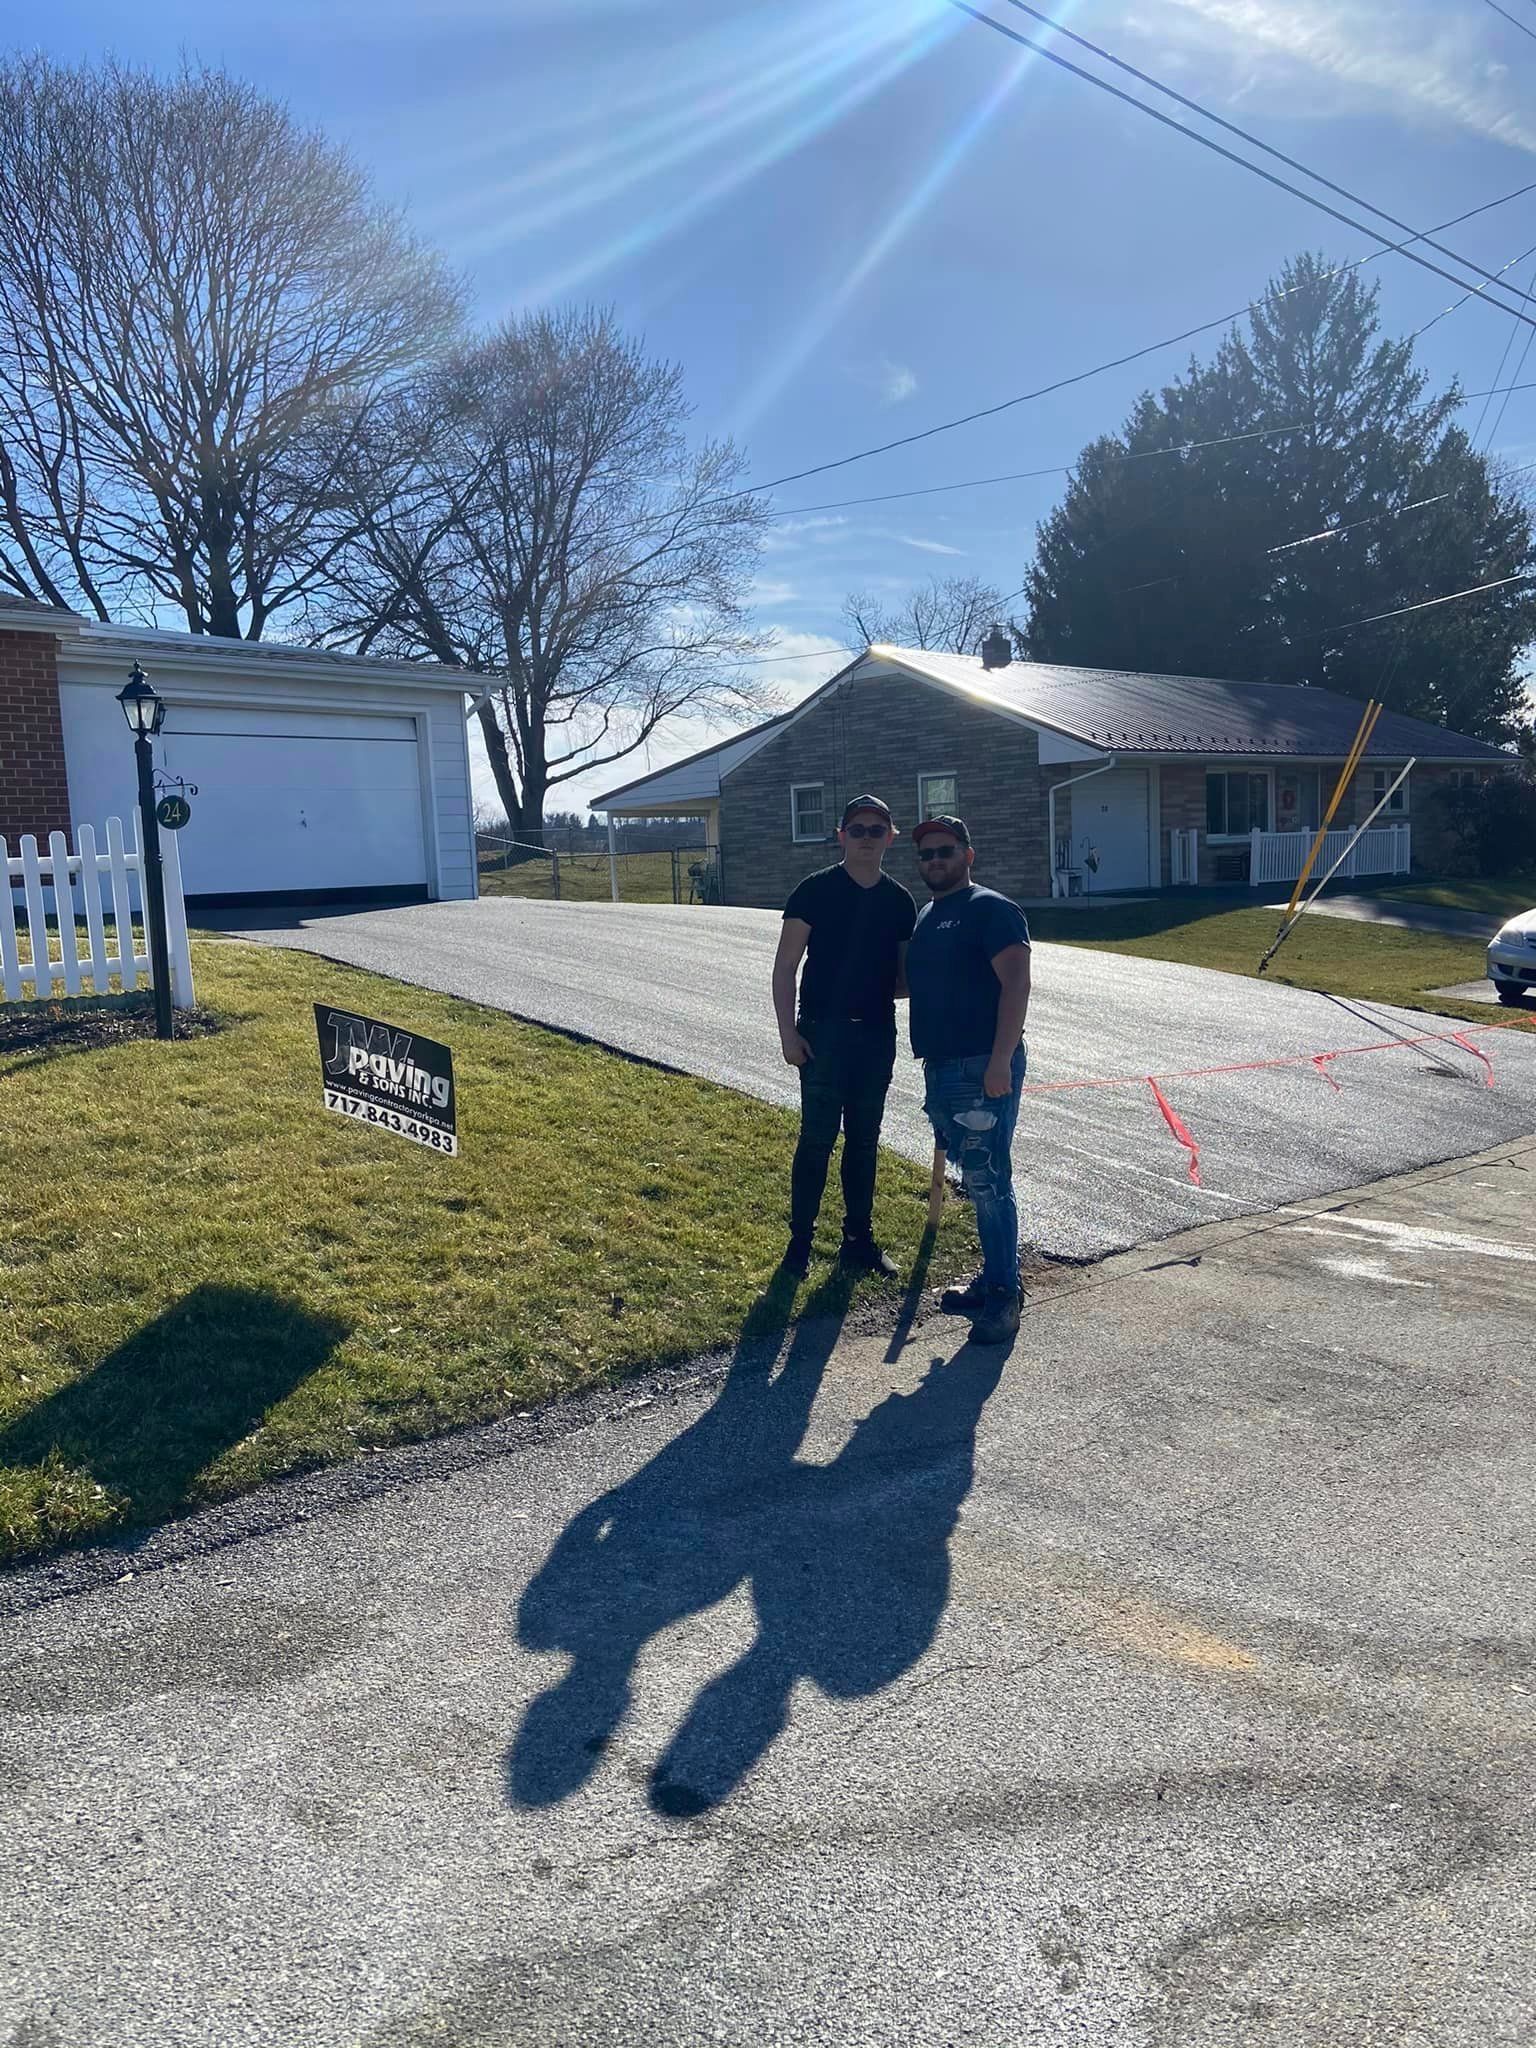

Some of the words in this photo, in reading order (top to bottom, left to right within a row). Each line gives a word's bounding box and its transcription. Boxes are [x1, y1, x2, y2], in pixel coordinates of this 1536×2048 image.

[163, 802, 181, 822] 24
[358, 1073, 369, 1085] &
[372, 1076, 406, 1099] SONS
[408, 1088, 433, 1109] INC.
[327, 1092, 453, 1153] 717.843.4983
